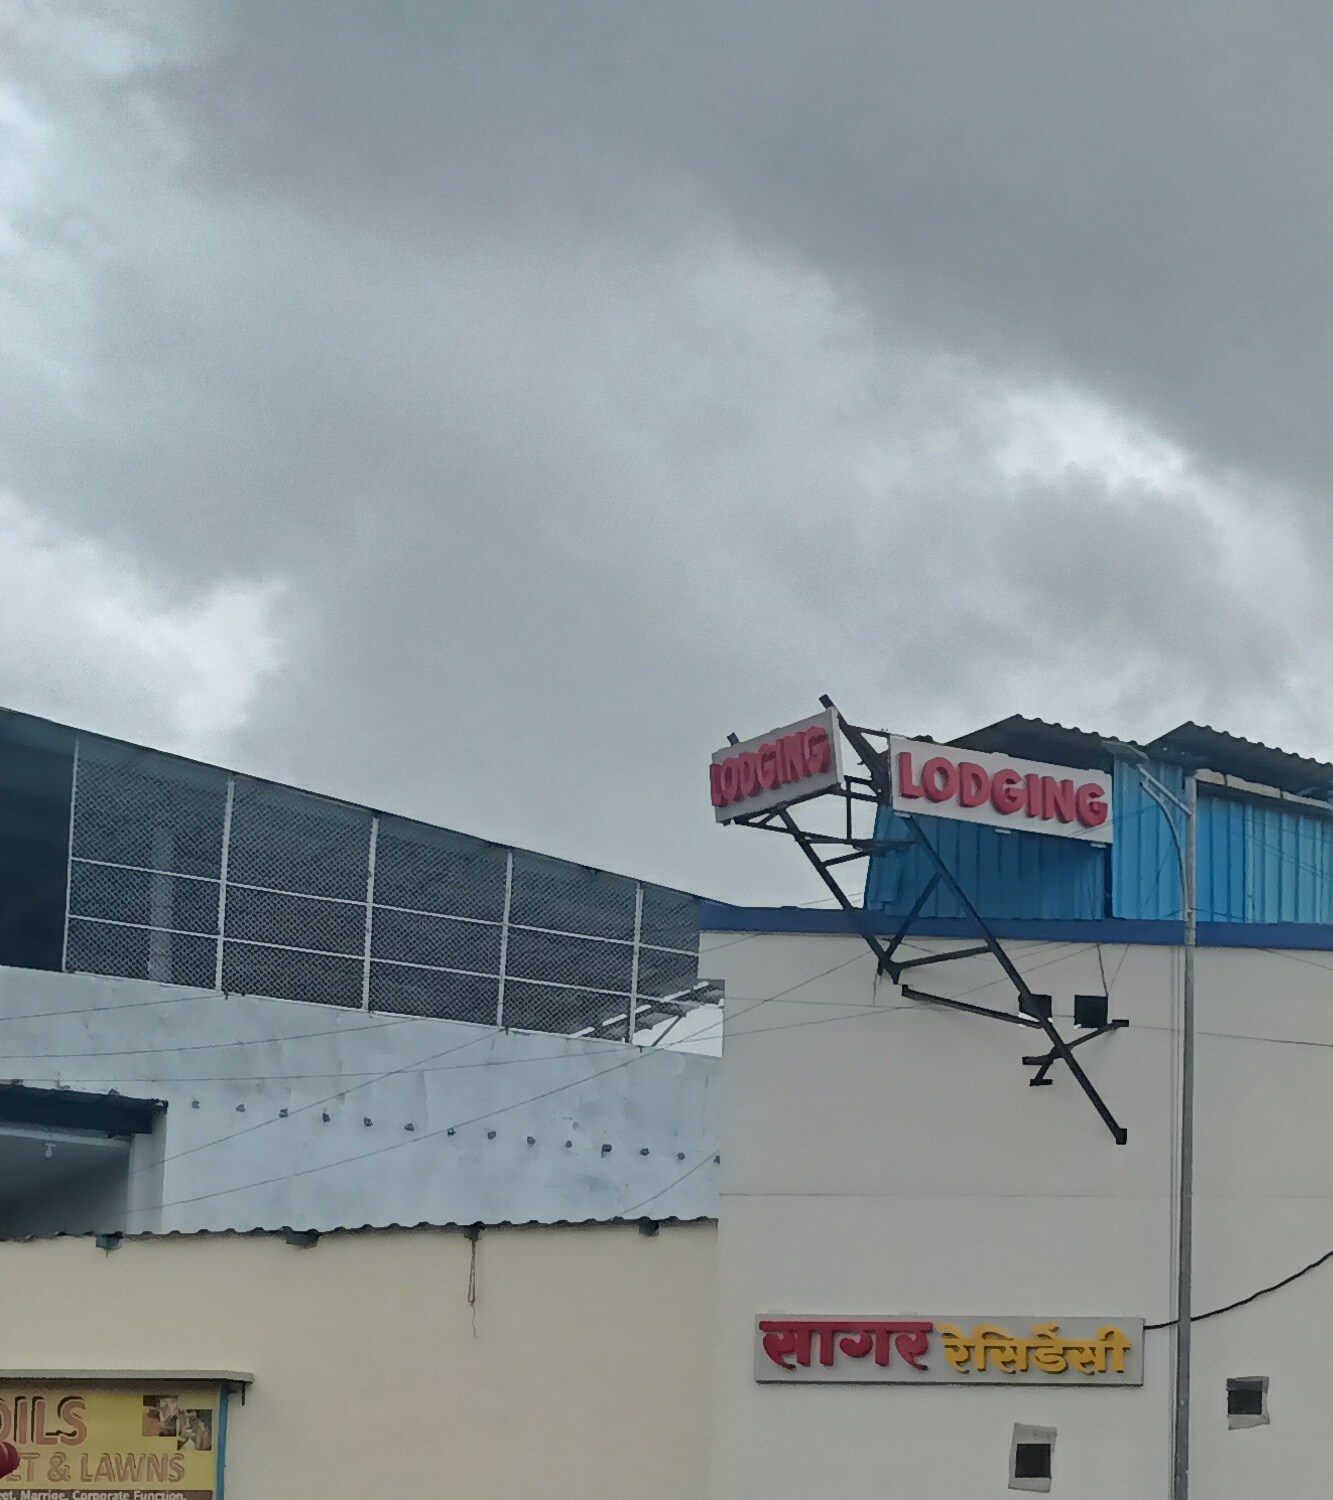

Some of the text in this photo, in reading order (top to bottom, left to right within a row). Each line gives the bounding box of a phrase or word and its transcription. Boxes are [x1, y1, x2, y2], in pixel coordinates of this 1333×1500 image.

[709, 725, 830, 808] LODGING
[897, 752, 1108, 827] LODGING
[759, 1321, 933, 1371] सागर
[47, 1452, 71, 1482] &
[81, 1453, 185, 1483] LAWNS
